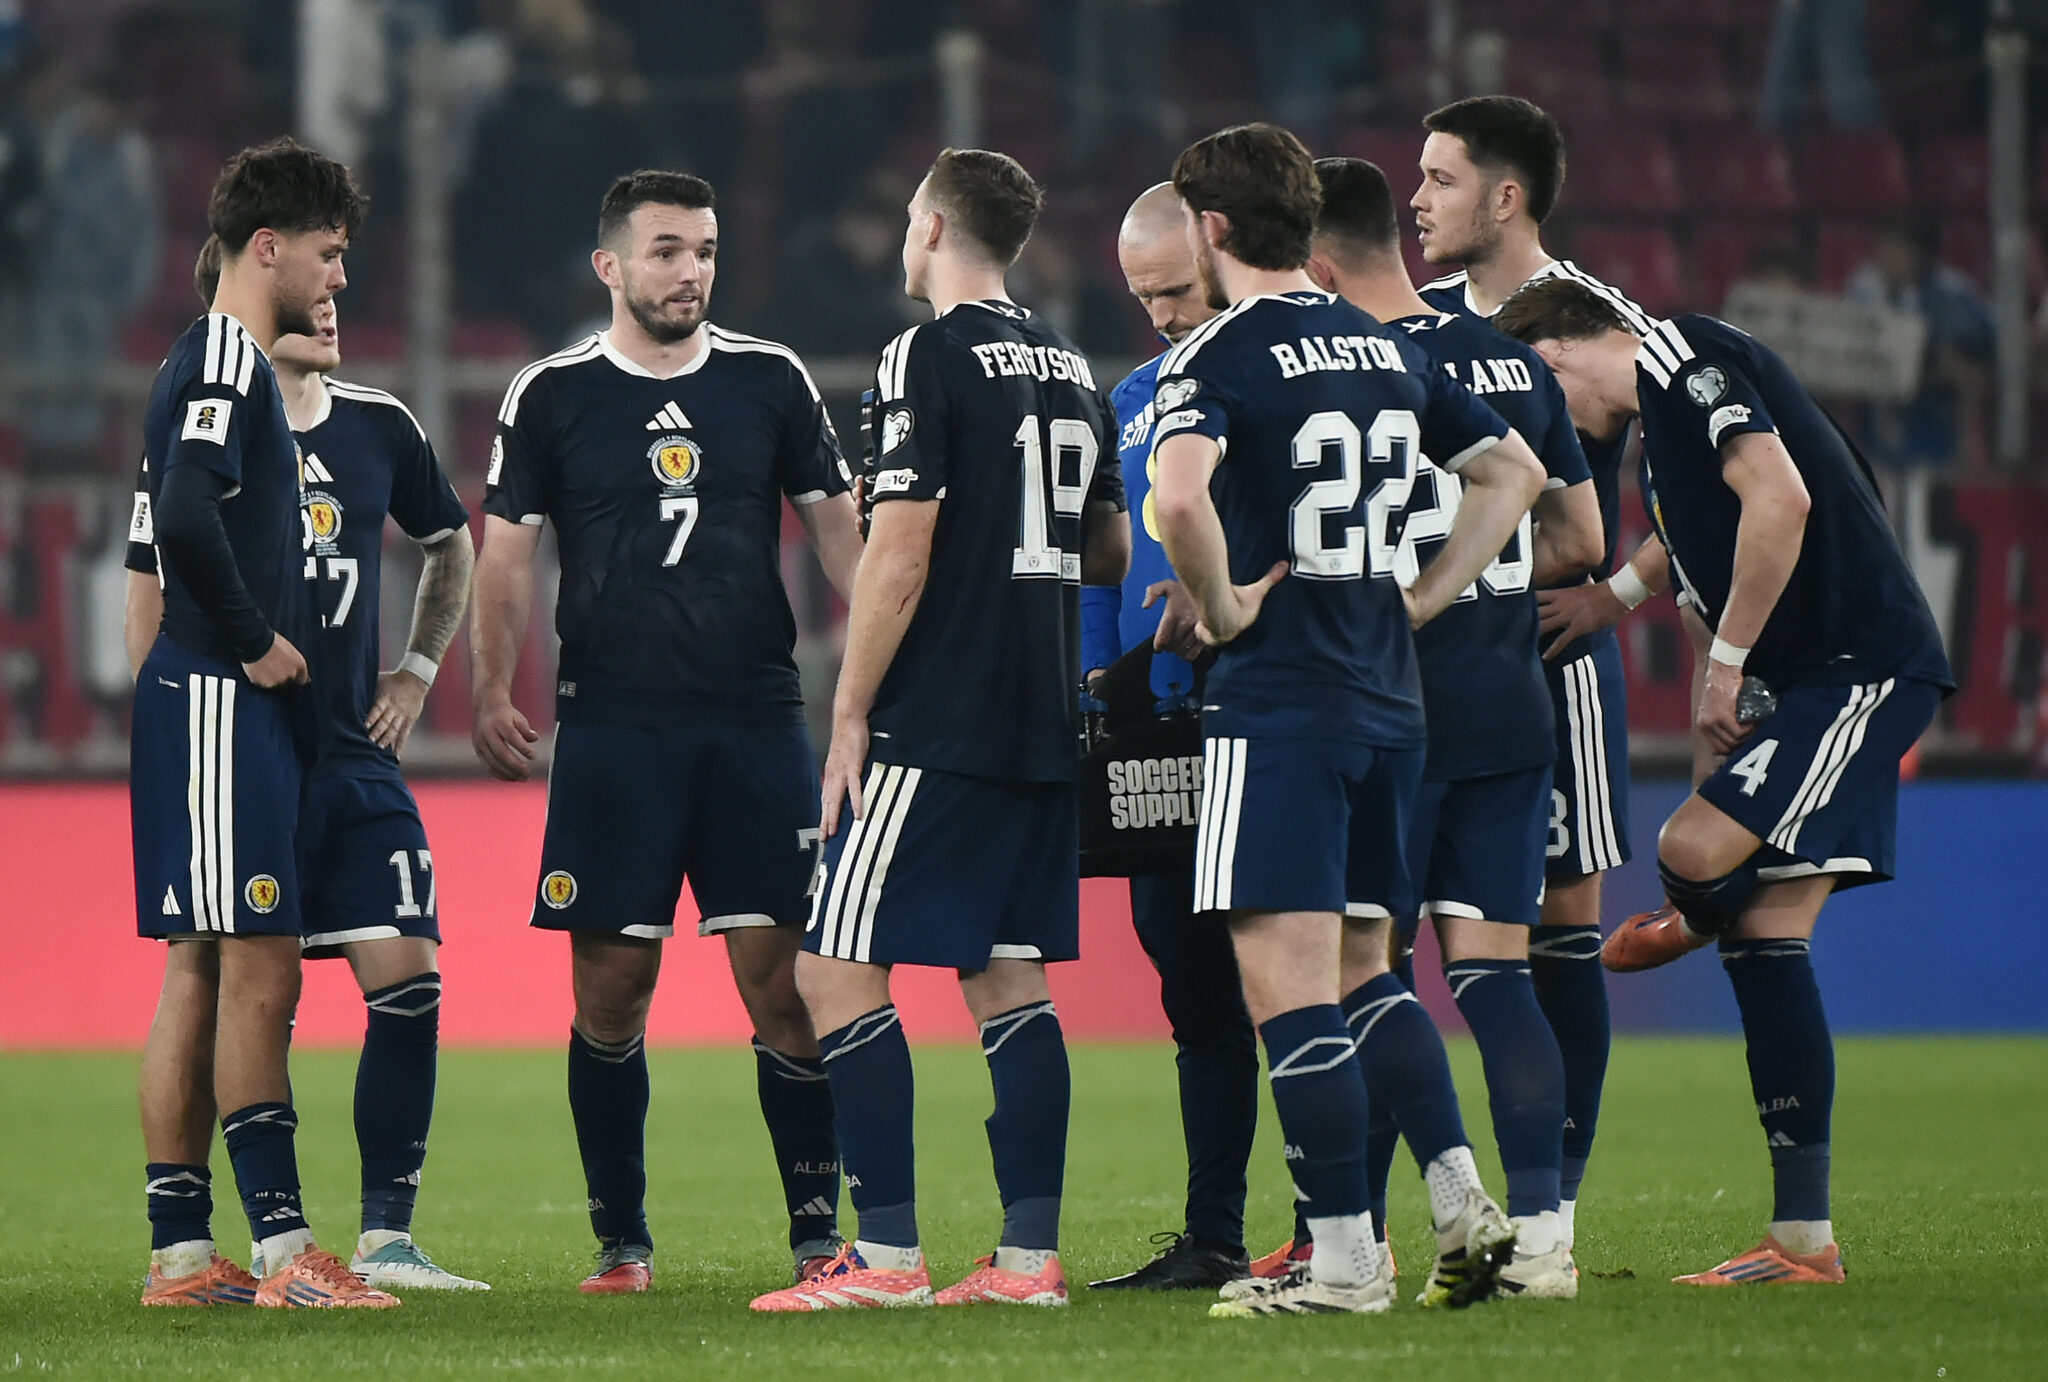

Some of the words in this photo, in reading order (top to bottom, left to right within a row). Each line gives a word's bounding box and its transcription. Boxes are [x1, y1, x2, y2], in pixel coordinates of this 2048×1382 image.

[970, 341, 1097, 392] FERGUSON
[1269, 335, 1407, 379] RALSTON
[1011, 414, 1099, 586] 19
[1287, 409, 1421, 580] 22
[659, 496, 699, 568] 7
[1729, 738, 1780, 797] 4
[389, 849, 437, 918] 17
[793, 1160, 838, 1175] ALBA
